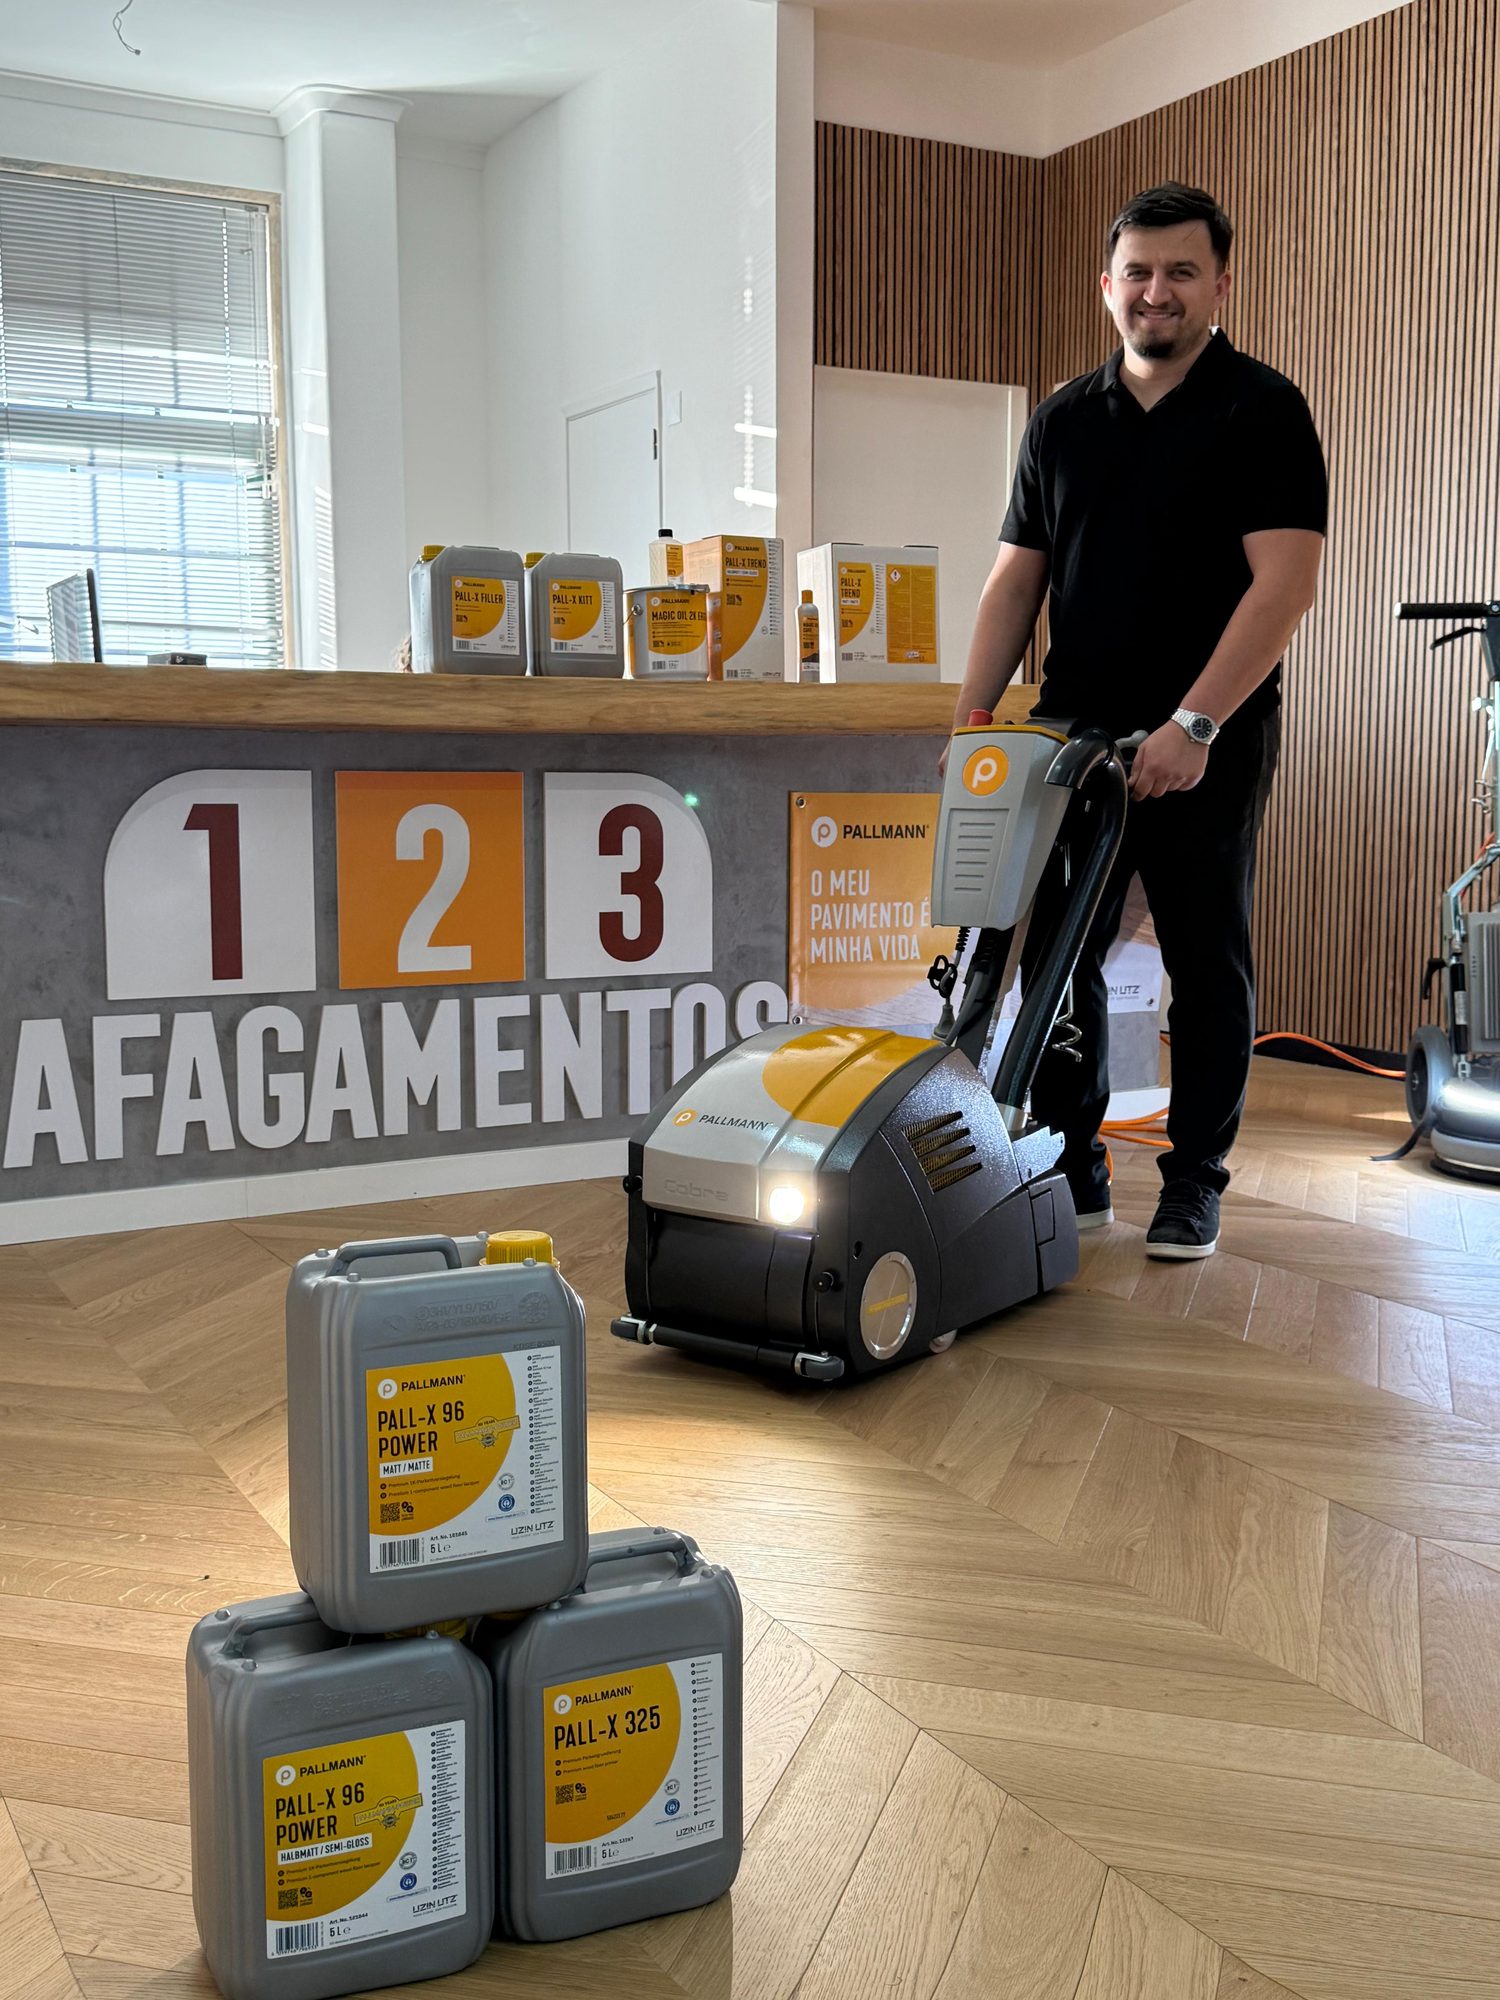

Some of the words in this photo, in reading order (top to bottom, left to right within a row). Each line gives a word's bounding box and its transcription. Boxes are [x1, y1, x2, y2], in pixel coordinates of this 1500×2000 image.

[726, 557, 746, 567] PALL-X
[747, 558, 767, 568] TREND
[840, 578, 862, 587] PALL-X
[455, 590, 479, 602] PALL-X
[480, 592, 504, 604] FILLER
[552, 594, 577, 605] PALL-X
[578, 595, 593, 605] KITT
[840, 588, 861, 598] TREND
[652, 610, 676, 621] MAGIC
[677, 610, 688, 621] OIL
[689, 611, 696, 620] 2K
[843, 824, 926, 840] PALLMANN
[183, 803, 243, 981] 1
[396, 802, 472, 974] 2
[598, 803, 665, 963] 3
[810, 870, 822, 897] O
[830, 869, 870, 896] MEU
[810, 901, 914, 930] PAVIMENTO
[810, 936, 872, 964] MINHA
[879, 933, 921, 961] VIDA
[698, 1114, 769, 1131] PALLMANN
[401, 1374, 464, 1392] PALLMANN
[378, 1404, 437, 1432] PALL-X
[442, 1400, 464, 1423] 96
[378, 1431, 438, 1458] POWER
[383, 1461, 402, 1475] MATT
[408, 1460, 431, 1472] MATTE
[575, 1686, 632, 1706] PALLMANN
[554, 1713, 618, 1750] PALL-X
[625, 1704, 661, 1736] 325
[300, 1756, 365, 1777] PALLMANN
[276, 1788, 336, 1820] PALL-X
[342, 1782, 365, 1807] 96
[276, 1816, 338, 1846] POWER
[280, 1846, 320, 1862] HALBMATT
[325, 1836, 370, 1854] SEMI-GLOSS
[602, 1849, 607, 1859] 5
[330, 1926, 335, 1938] 5
